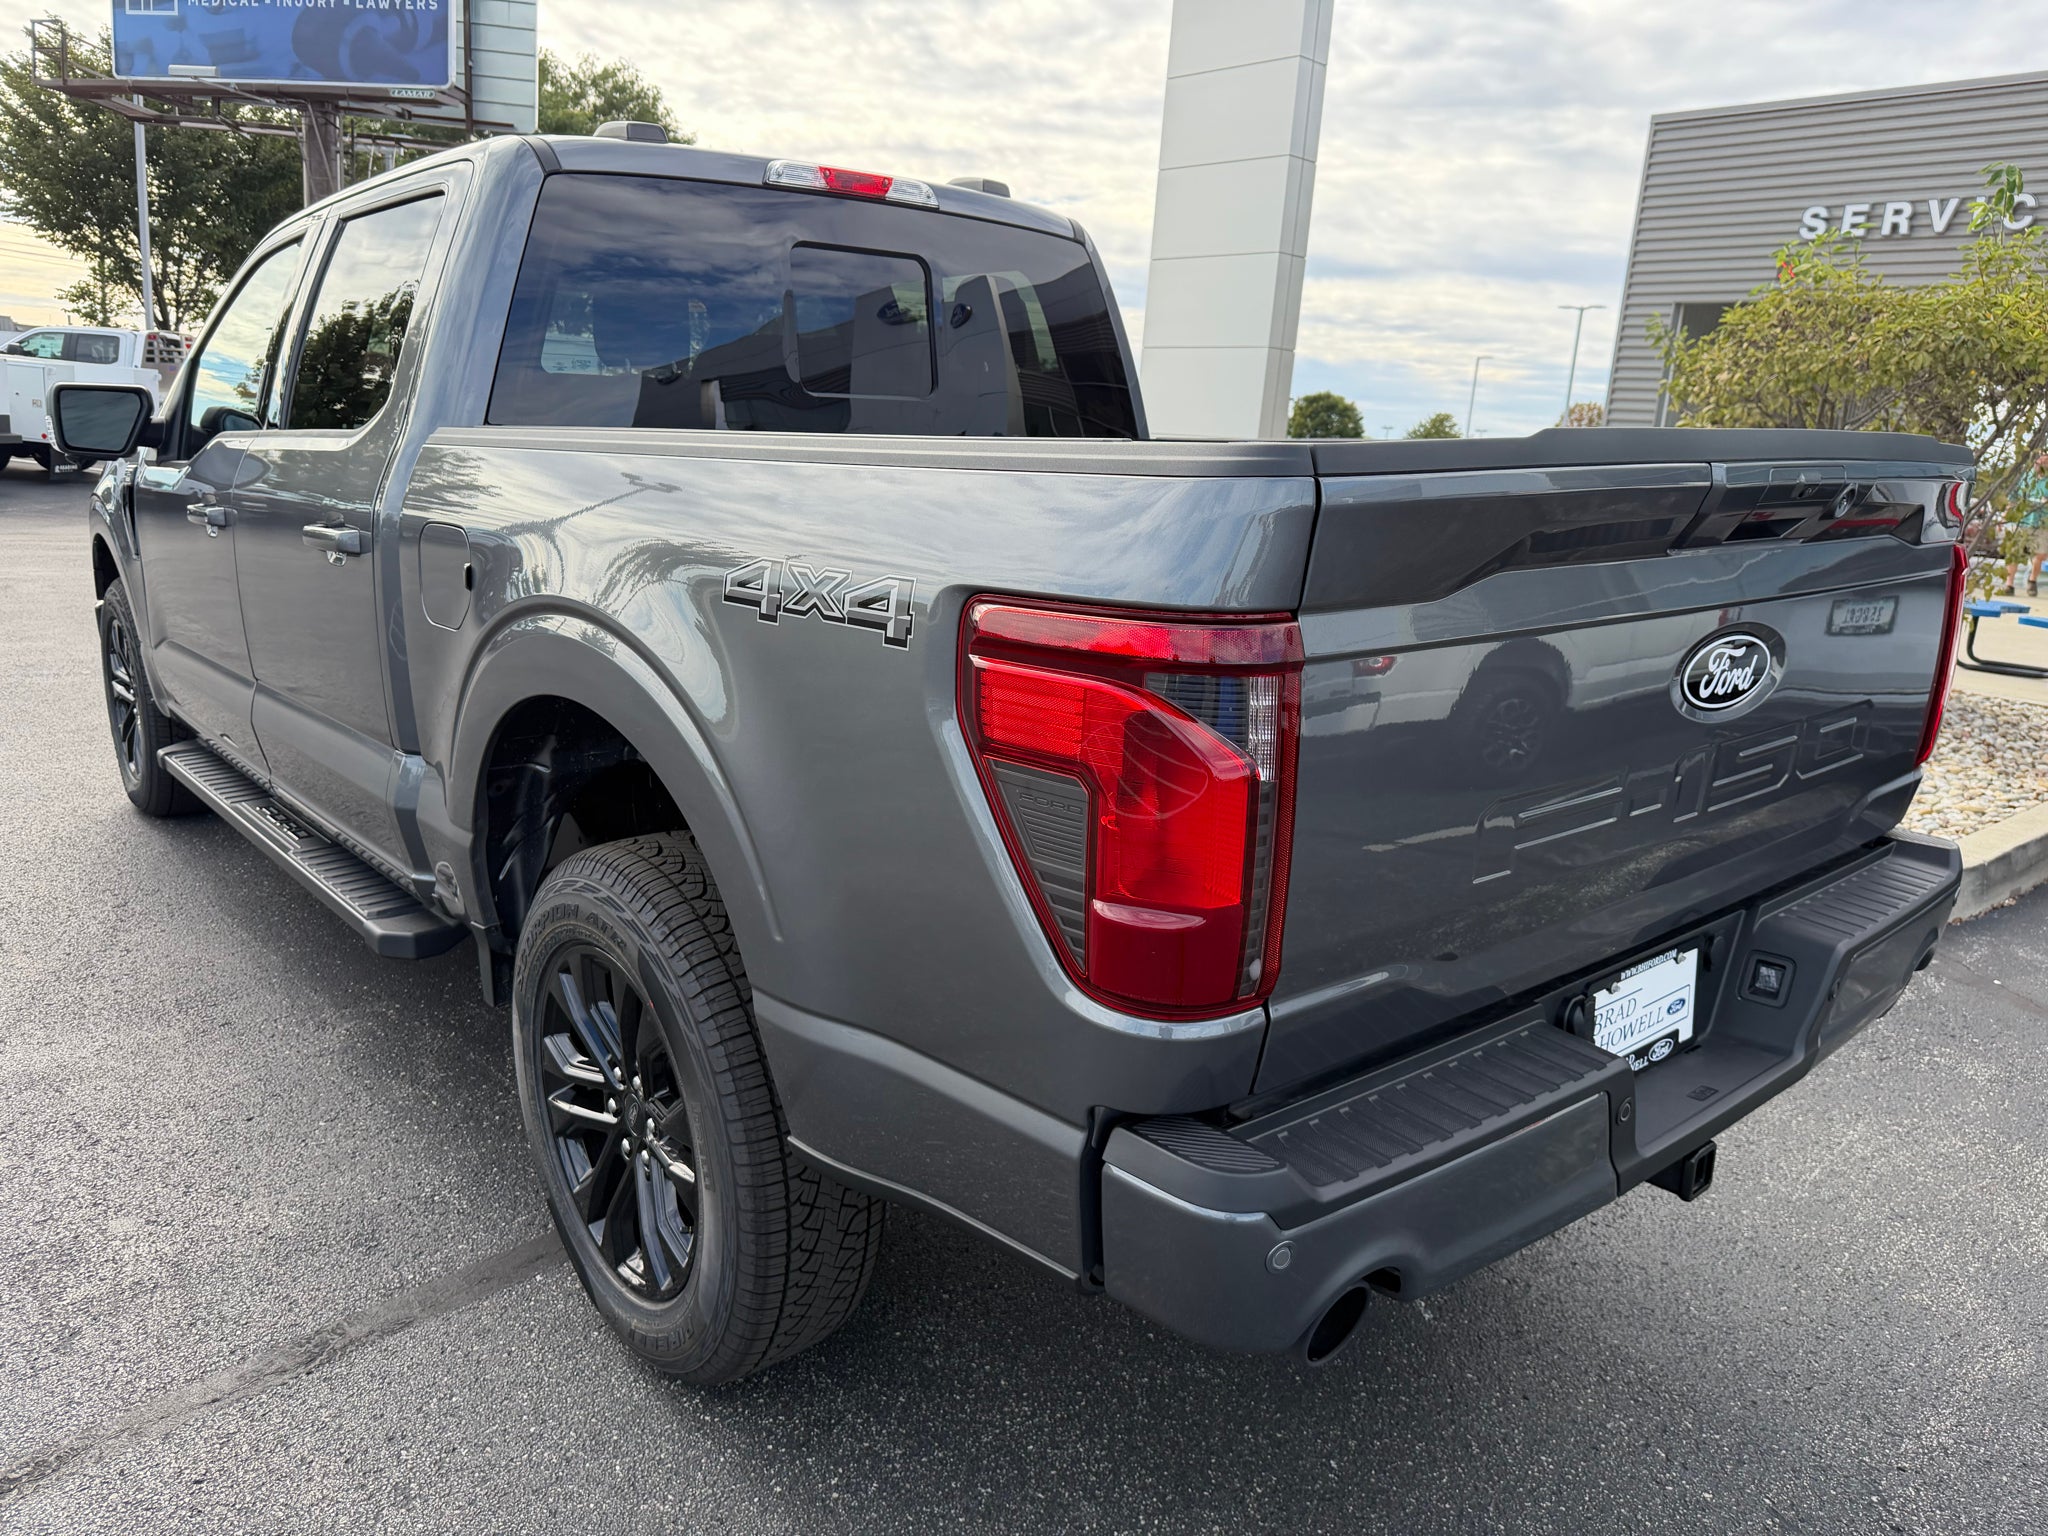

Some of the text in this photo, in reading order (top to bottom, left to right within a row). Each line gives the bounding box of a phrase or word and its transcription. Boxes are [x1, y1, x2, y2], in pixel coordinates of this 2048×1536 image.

[355, 0, 438, 10] LAWYERS
[392, 89, 434, 98] LAMAR
[1697, 644, 1760, 700] Ford
[1019, 792, 1084, 816] FORD
[1594, 997, 1637, 1036] BRAD
[1600, 1006, 1664, 1051] HOWELL
